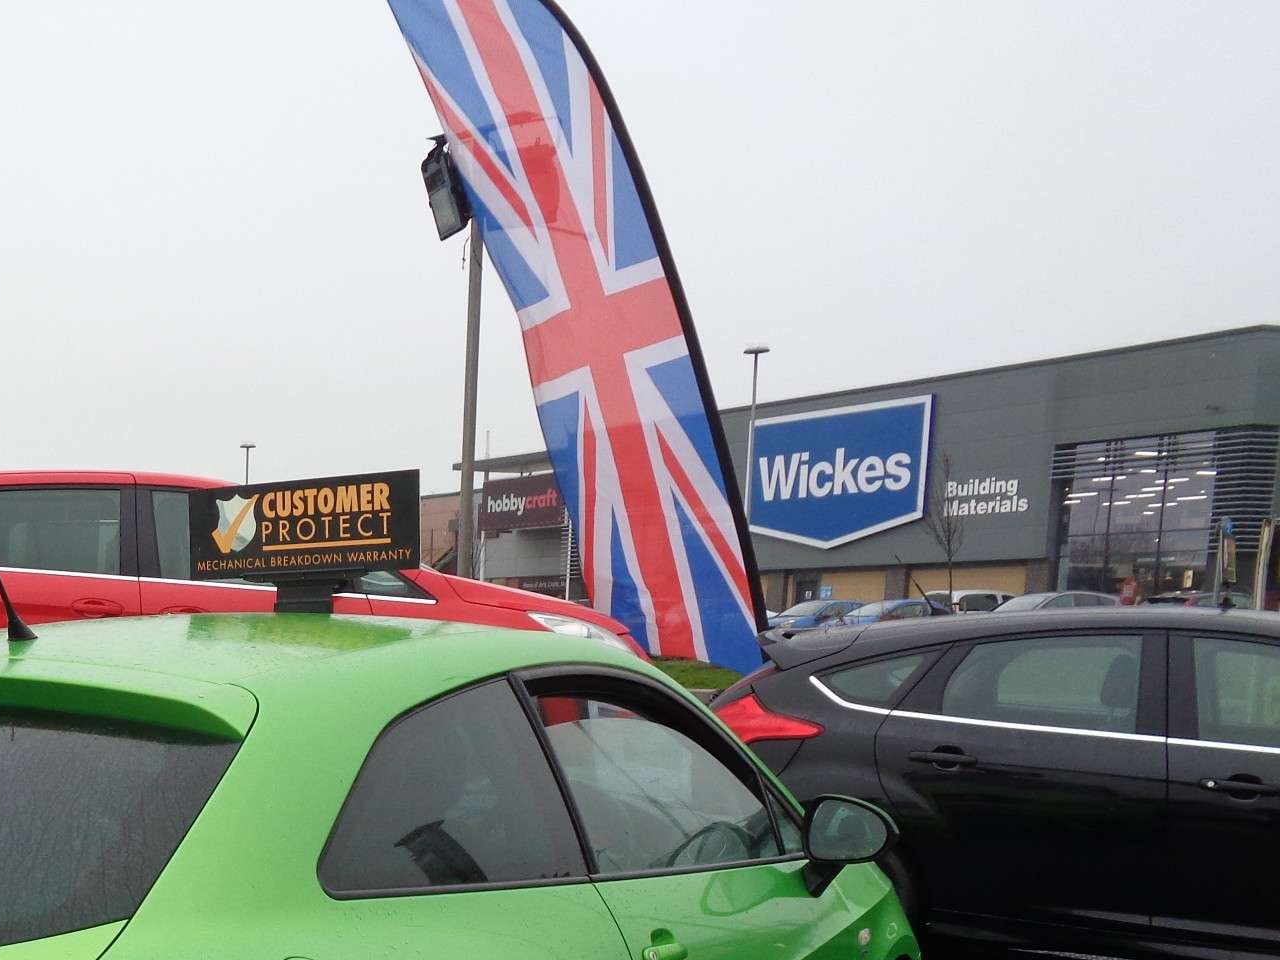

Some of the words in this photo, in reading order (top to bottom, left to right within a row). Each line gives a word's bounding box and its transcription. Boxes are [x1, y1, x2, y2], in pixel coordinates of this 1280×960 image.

[758, 447, 912, 502] Wickes
[944, 477, 1020, 500] Building
[261, 482, 391, 519] CUSTOMER
[487, 487, 558, 516] hobbycraft
[943, 495, 1030, 518] Materials
[261, 512, 392, 543] PROTECT
[197, 556, 267, 572] MECHANICAL
[270, 552, 342, 568] BREAKDOWN
[347, 548, 412, 563] WARRANTY
